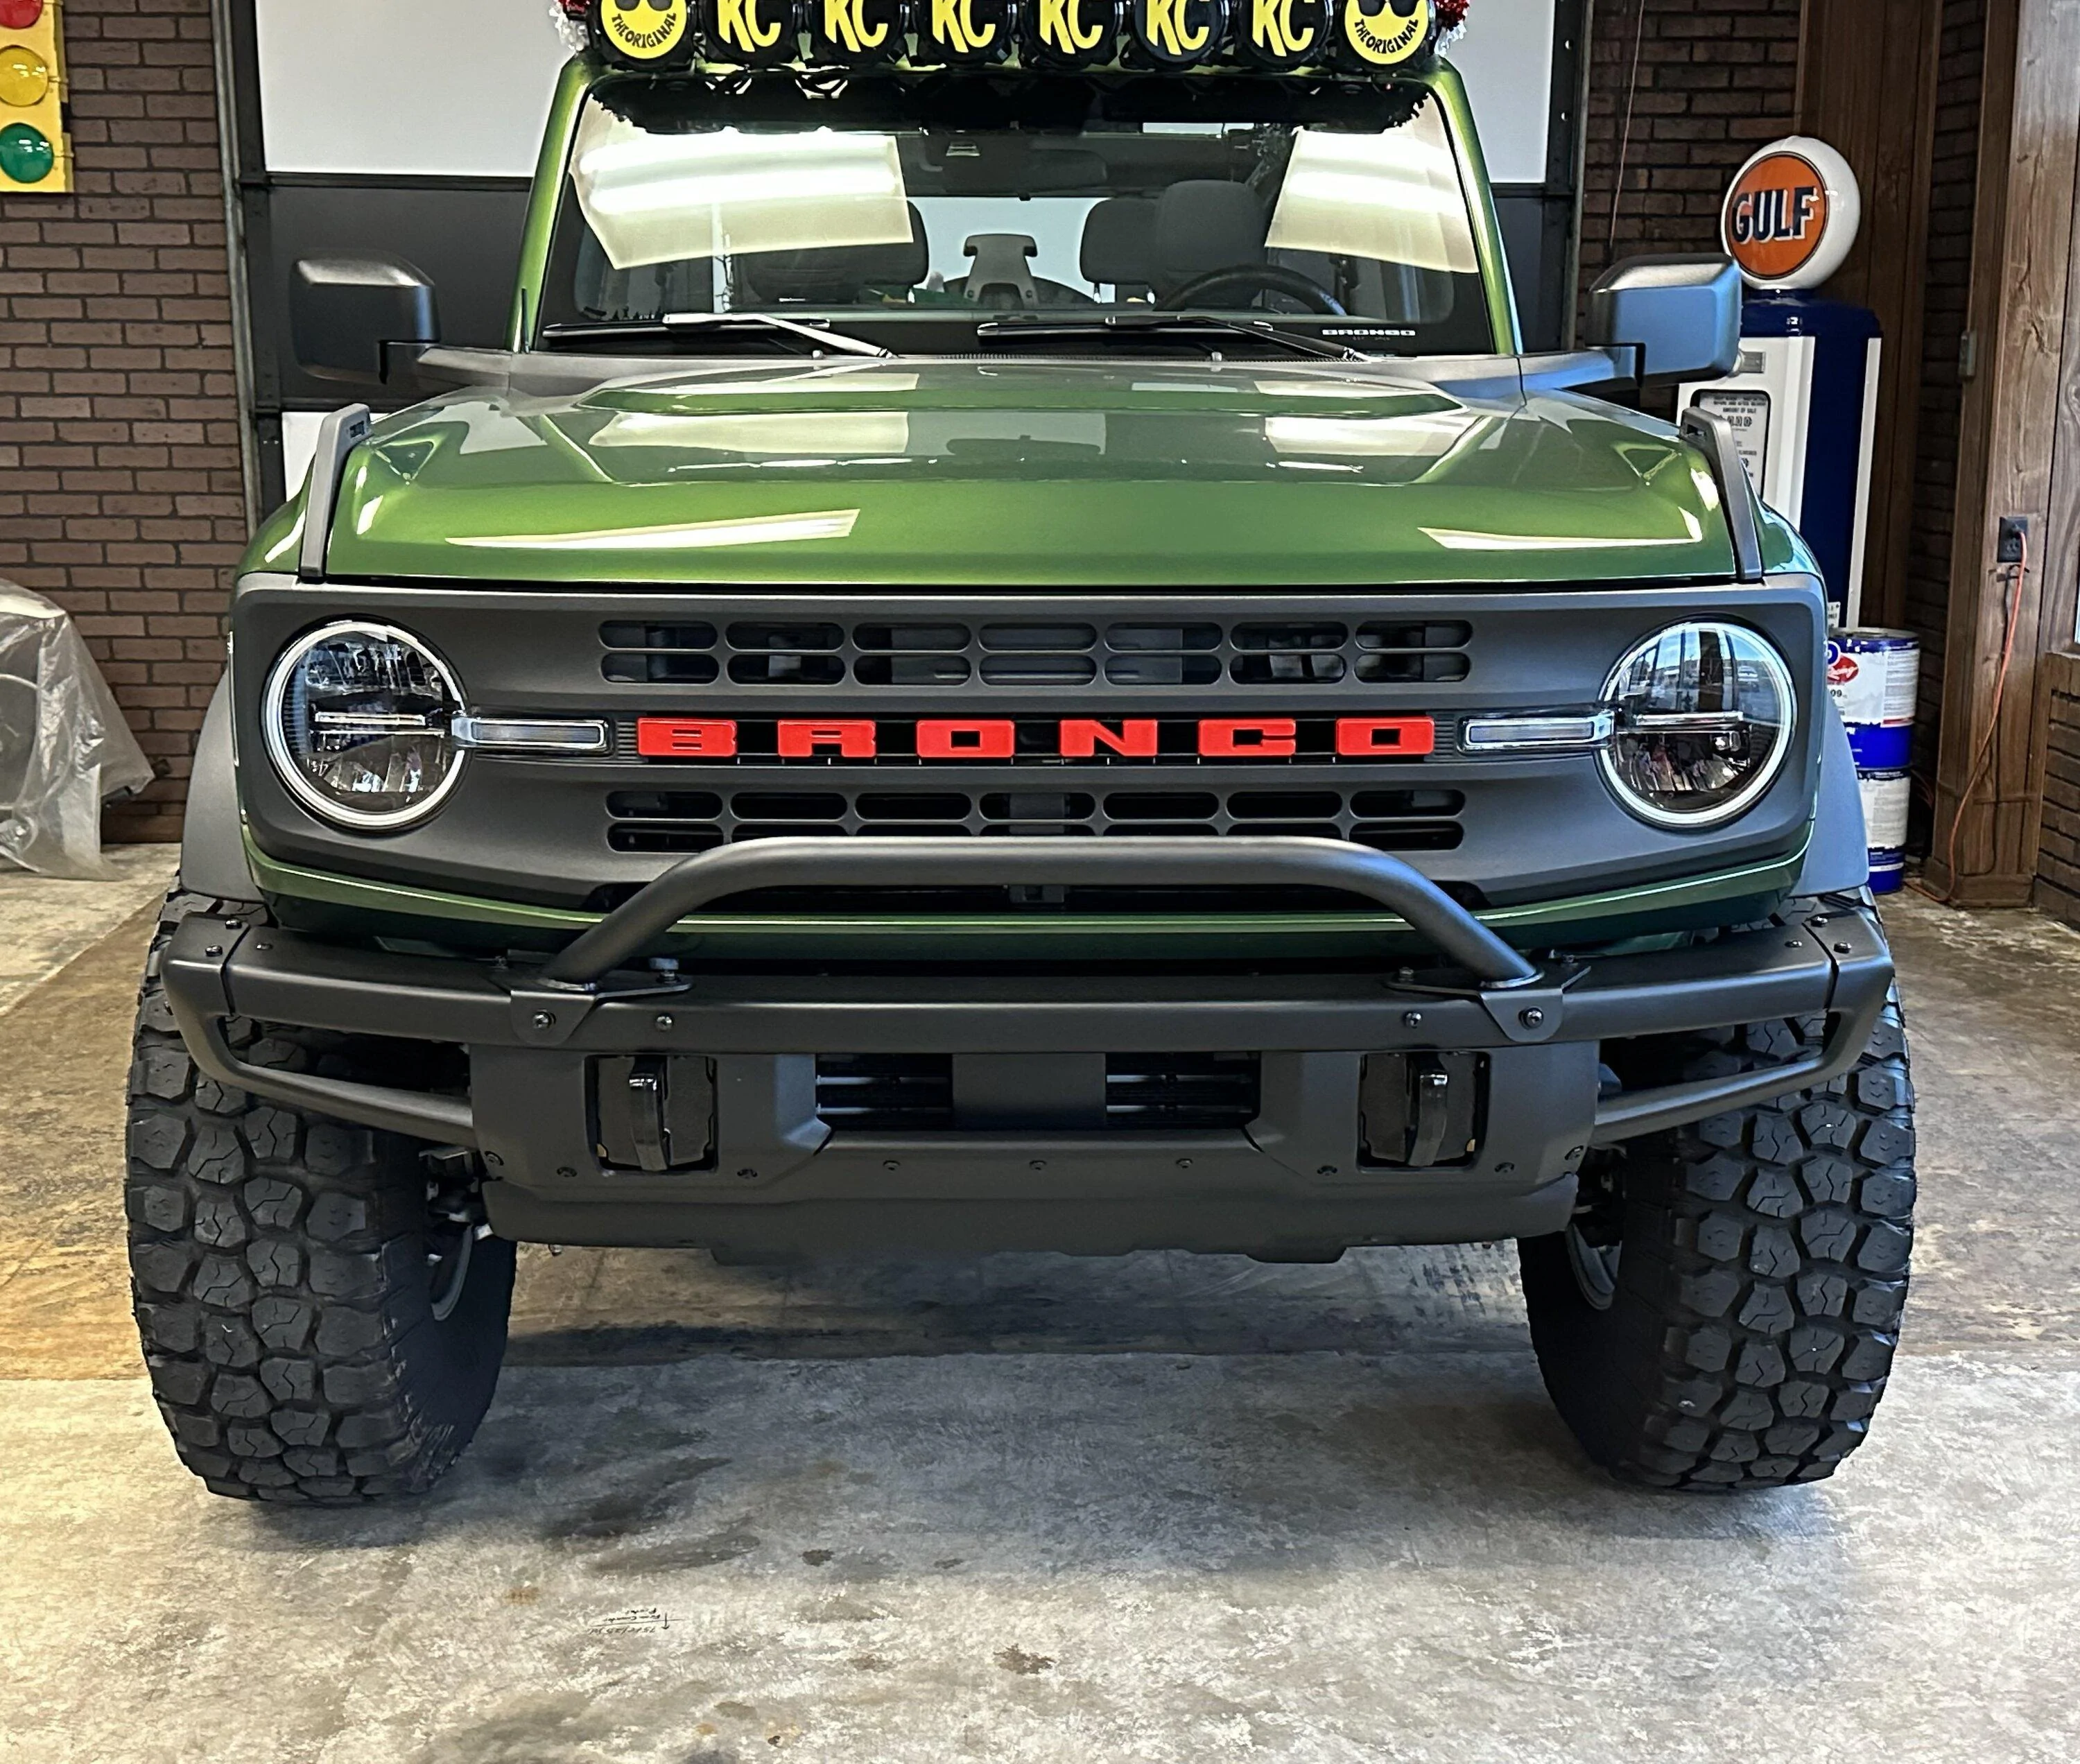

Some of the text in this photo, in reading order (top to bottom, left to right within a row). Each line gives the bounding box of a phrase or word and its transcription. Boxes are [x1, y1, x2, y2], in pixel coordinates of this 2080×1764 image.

[612, 12, 677, 49] THE ORIGINAL
[718, 0, 781, 52] KC
[825, 0, 888, 52] KC
[932, 0, 996, 53] KC
[1040, 0, 1103, 54] KC
[1147, 0, 1209, 55] KC
[1252, 0, 1315, 57] KC
[1354, 18, 1419, 54] THE ORIGINAL
[1732, 187, 1818, 244] GULF
[637, 716, 1435, 758] BRONCO
